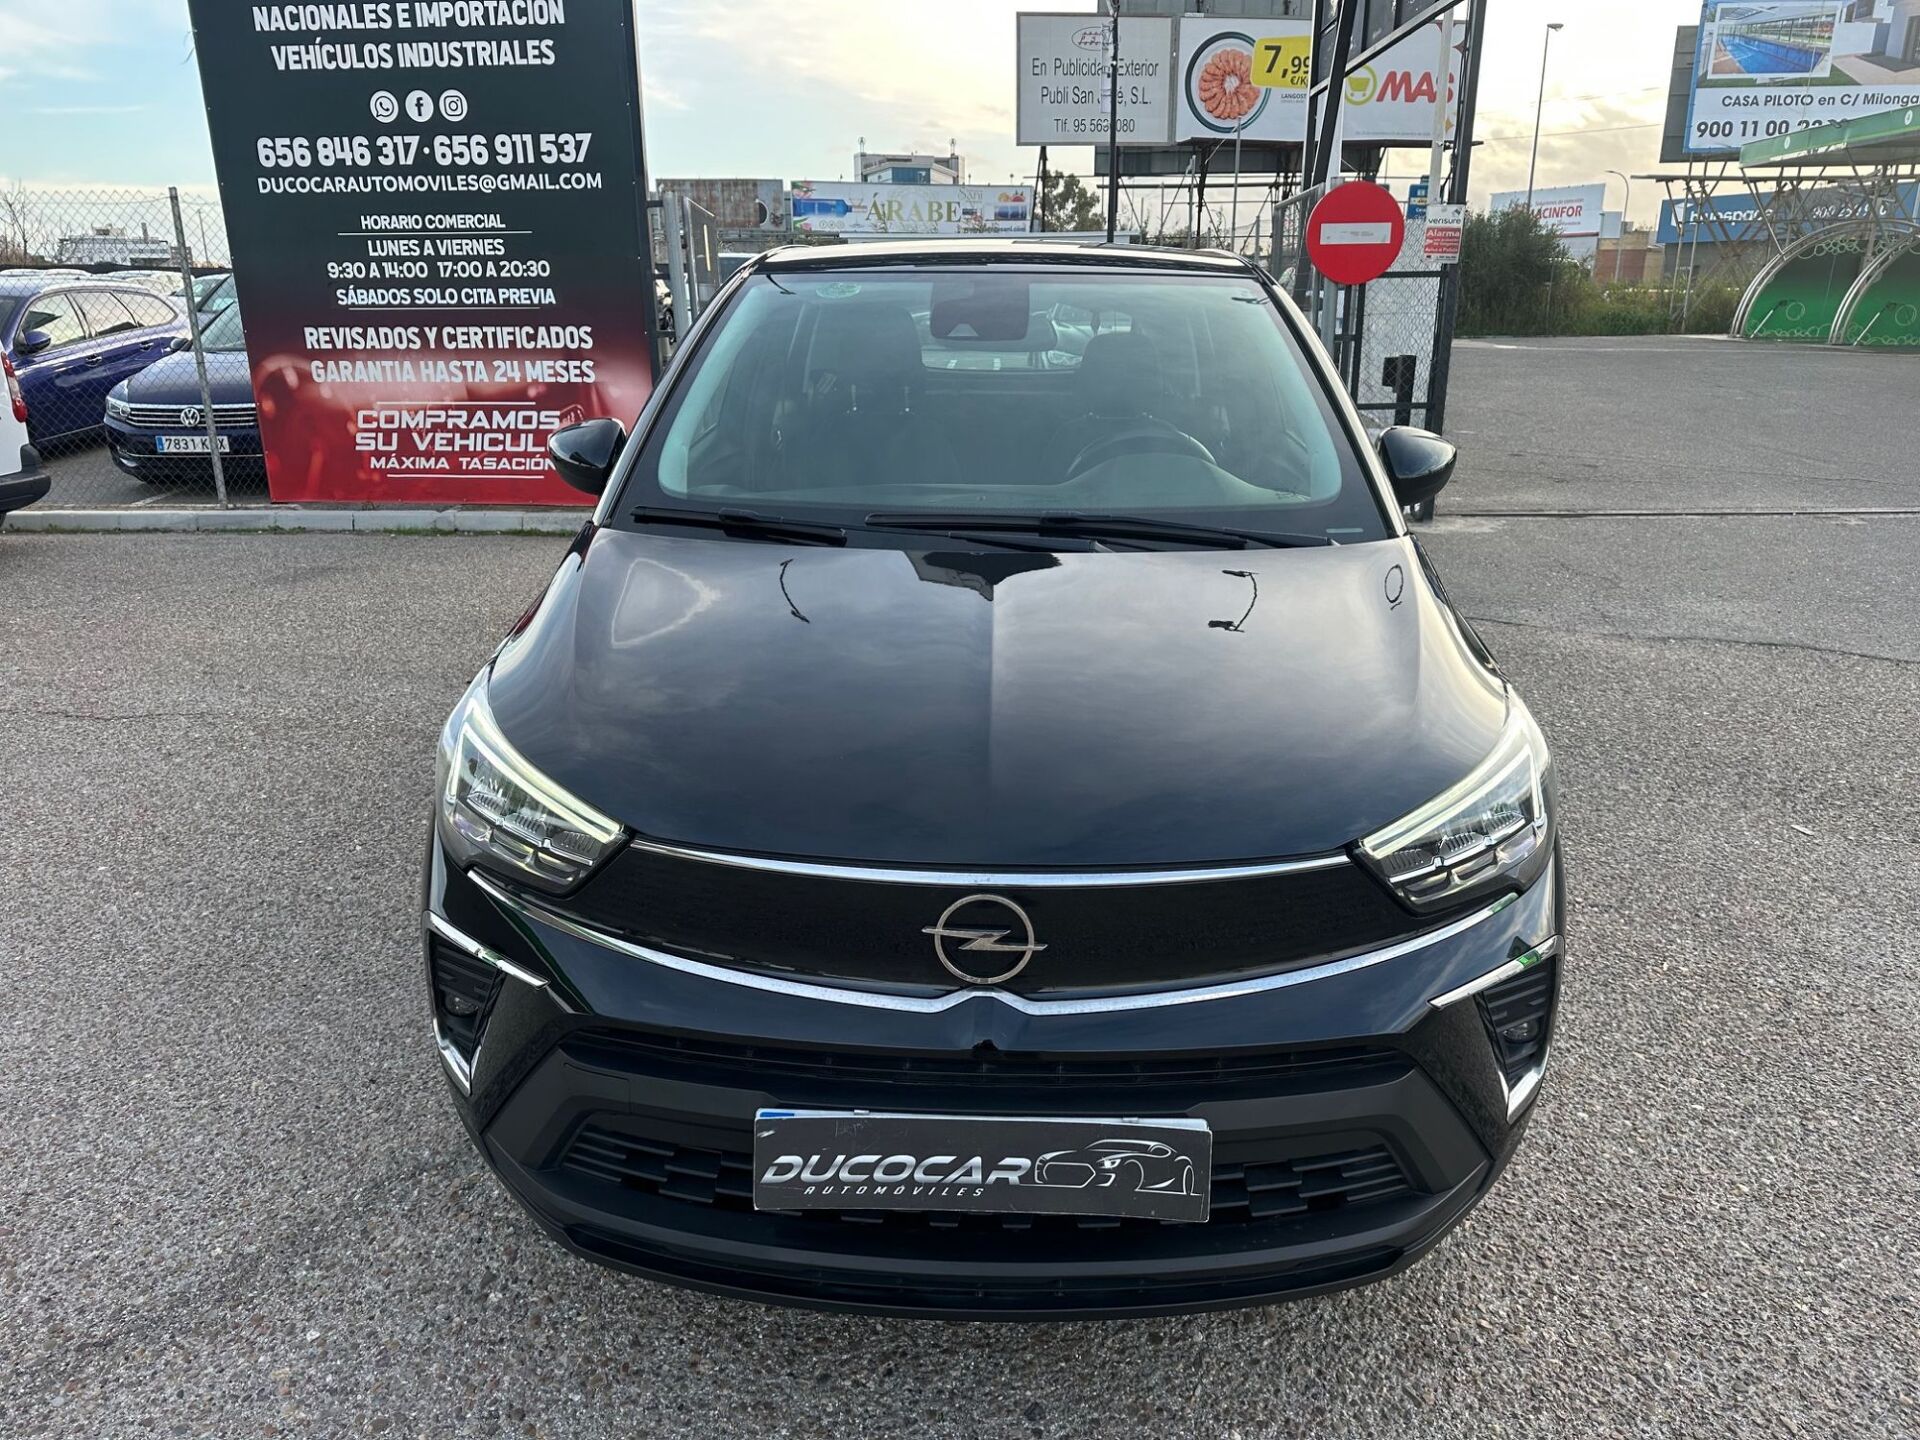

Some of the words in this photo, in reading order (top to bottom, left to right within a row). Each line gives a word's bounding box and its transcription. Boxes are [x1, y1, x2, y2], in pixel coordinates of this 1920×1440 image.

[252, 3, 394, 31] NACIONALES
[397, 2, 412, 28] E
[271, 37, 394, 70] VEHÍCULOS
[397, 39, 556, 67] INDUSTRIALES
[1264, 44, 1309, 78] 7,99
[1032, 58, 1047, 76] En
[1054, 57, 1103, 76] Publicida
[1117, 57, 1159, 77] Exterior
[1041, 85, 1069, 104] Publi
[1072, 86, 1094, 104] San
[1130, 86, 1152, 105] S.L.
[1721, 94, 1760, 107] CASA
[1764, 94, 1814, 107] PILOTO
[1818, 95, 1836, 105] en
[1840, 93, 1859, 107] C/
[1054, 118, 1069, 132] Tlf.
[1073, 118, 1087, 132] 95
[1696, 120, 1733, 138] 900
[1740, 120, 1758, 137] 11
[1765, 120, 1790, 136] 00
[256, 136, 311, 168] 656
[316, 135, 371, 166] 846
[433, 134, 489, 166] 656
[494, 133, 536, 164] 911
[539, 132, 592, 163] 537
[257, 173, 602, 194] DUCOCARAUTOMOVILES@GMAIL.COM
[865, 192, 962, 223] ÁRABE
[360, 214, 423, 230] HORARIO
[425, 213, 506, 229] COMERCIAL
[1427, 229, 1460, 237] Alarma
[367, 239, 419, 257] LUNES
[423, 239, 434, 256] A
[436, 238, 505, 255] VIERNES
[327, 261, 366, 279] 9:30
[369, 262, 380, 278] A
[382, 261, 428, 278] 14:00
[437, 260, 483, 278] 17:00
[486, 261, 497, 277] A
[499, 260, 550, 278] 20:30
[336, 284, 411, 306] SÁBADOS
[413, 288, 458, 305] SOLO
[460, 288, 496, 304] CITA
[498, 287, 556, 305] PREVIA
[304, 326, 421, 350] REVISADOS
[424, 326, 437, 349] Y
[442, 326, 593, 349] CERTIFICADOS
[310, 360, 417, 383] GARANTIA
[420, 360, 490, 383] HASTA
[493, 360, 520, 382] 24
[525, 360, 596, 383] MESES
[357, 410, 561, 430] COMPRAMOS
[165, 438, 197, 450] 7831
[201, 438, 226, 450] KX
[355, 432, 398, 451] SU
[411, 432, 551, 452] VEHICUL
[370, 453, 450, 470] MÁXIMA
[760, 1154, 1032, 1185] DUCOCAR
